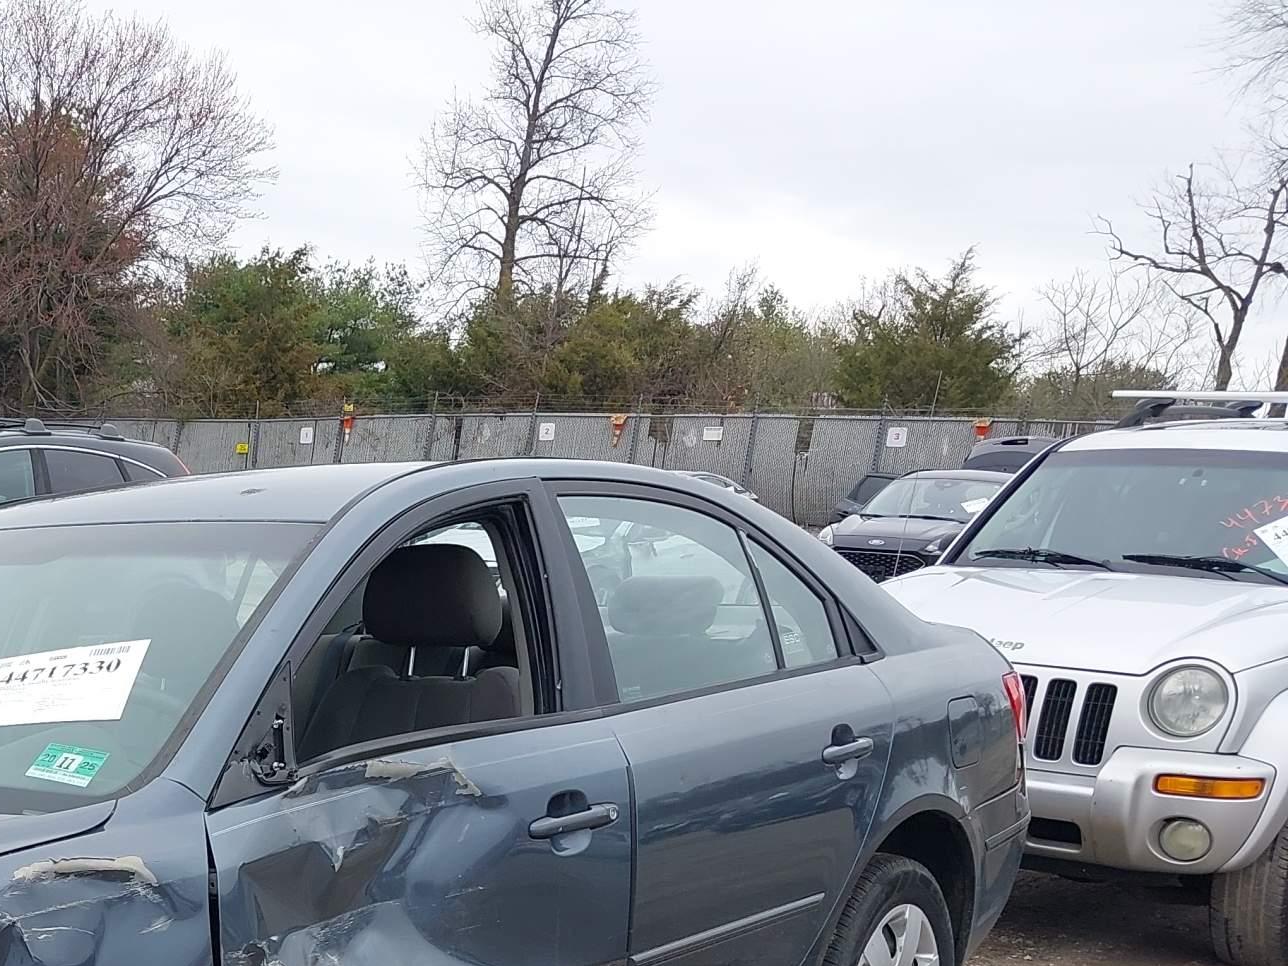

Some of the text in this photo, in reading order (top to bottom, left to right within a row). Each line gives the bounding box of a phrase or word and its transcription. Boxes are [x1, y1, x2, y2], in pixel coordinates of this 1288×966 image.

[544, 427, 551, 436] 2
[893, 431, 901, 441] 3
[0, 657, 122, 685] 44717330
[39, 752, 57, 764] 20
[55, 755, 76, 770] 11
[79, 760, 97, 771] 25
